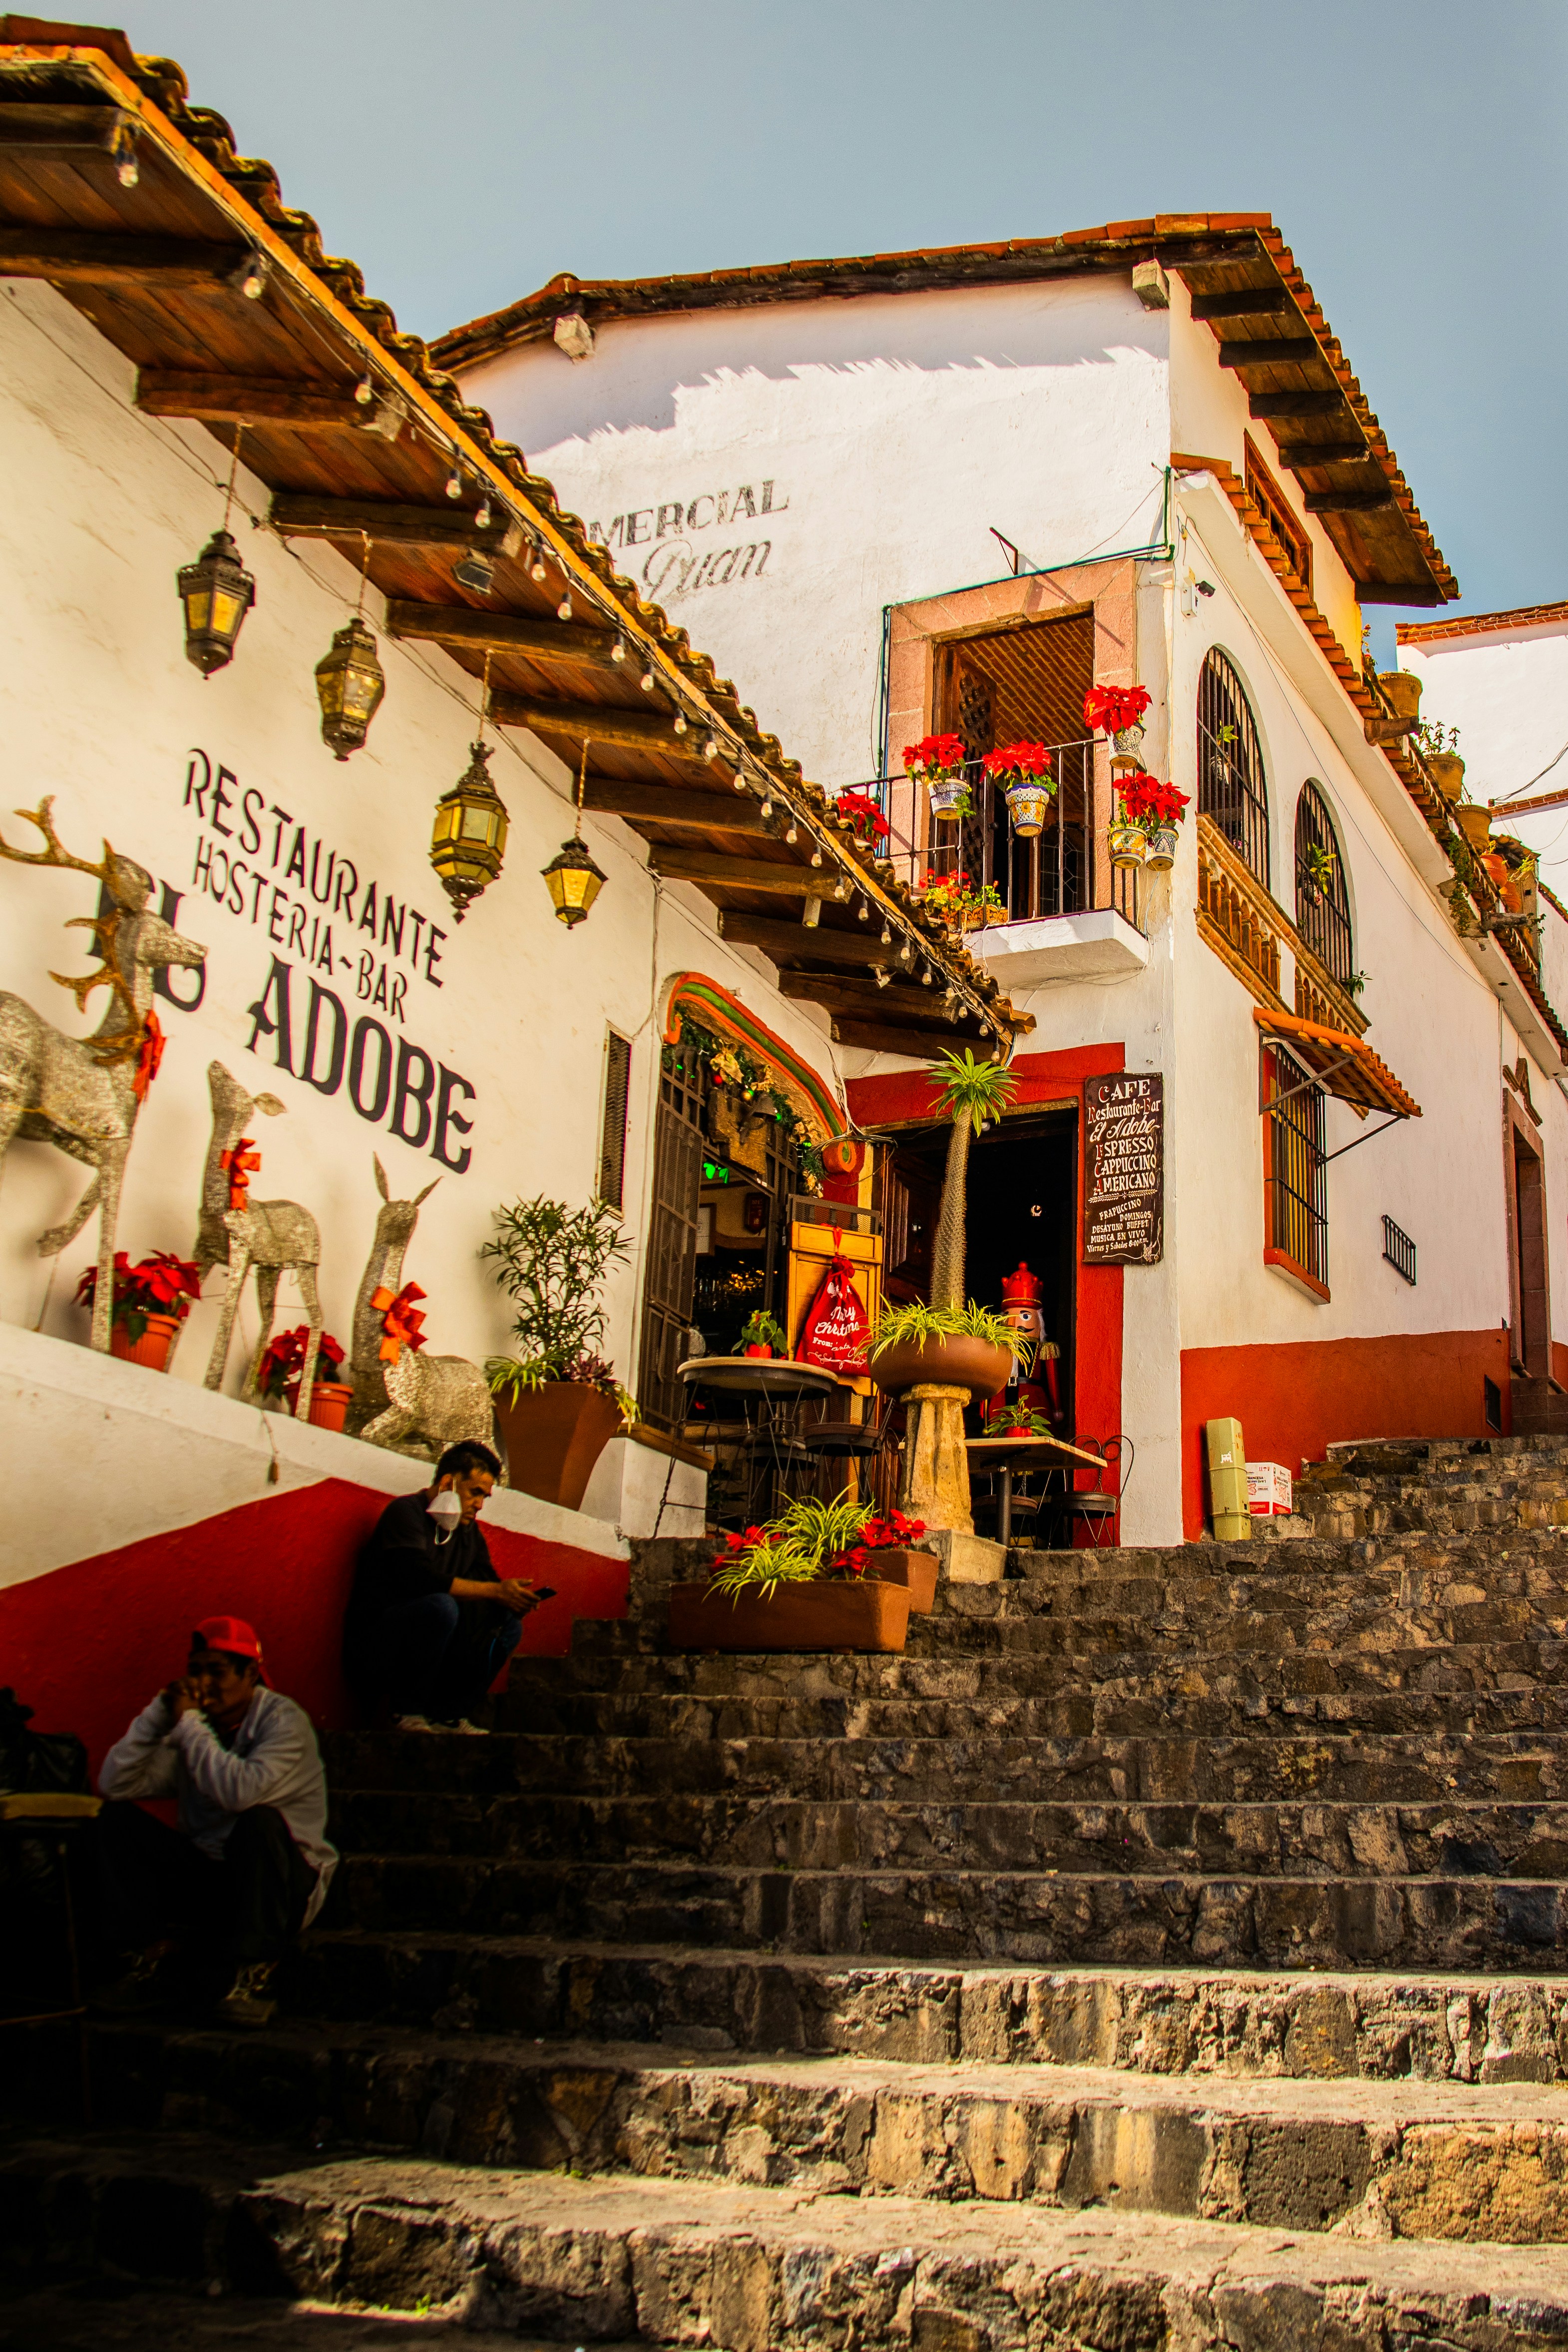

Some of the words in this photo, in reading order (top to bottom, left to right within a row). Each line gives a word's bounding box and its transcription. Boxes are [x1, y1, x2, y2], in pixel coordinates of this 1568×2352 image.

[183, 748, 447, 988] RESTAURANTE
[245, 952, 476, 1175] ADOBE
[1099, 1079, 1150, 1103] CAFE
[1089, 1121, 1107, 1143] El
[1106, 1114, 1161, 1139] Adobe
[1096, 1136, 1154, 1160] ESPRESSO
[1094, 1154, 1157, 1178] CAPPUCCINO
[1094, 1172, 1156, 1196] AMERICANO
[1099, 1198, 1142, 1220] FRAPUCCINO
[1120, 1210, 1152, 1222] DOMINGOS
[1091, 1233, 1115, 1243] MUSICA
[1117, 1232, 1126, 1240] EN
[1128, 1229, 1145, 1238] VIVO
[1092, 1222, 1123, 1234] DESAYUNO
[1127, 1219, 1149, 1229] BUFFET
[1105, 1244, 1109, 1253] y
[812, 1337, 833, 1348] From:
[831, 1342, 851, 1351] anta
